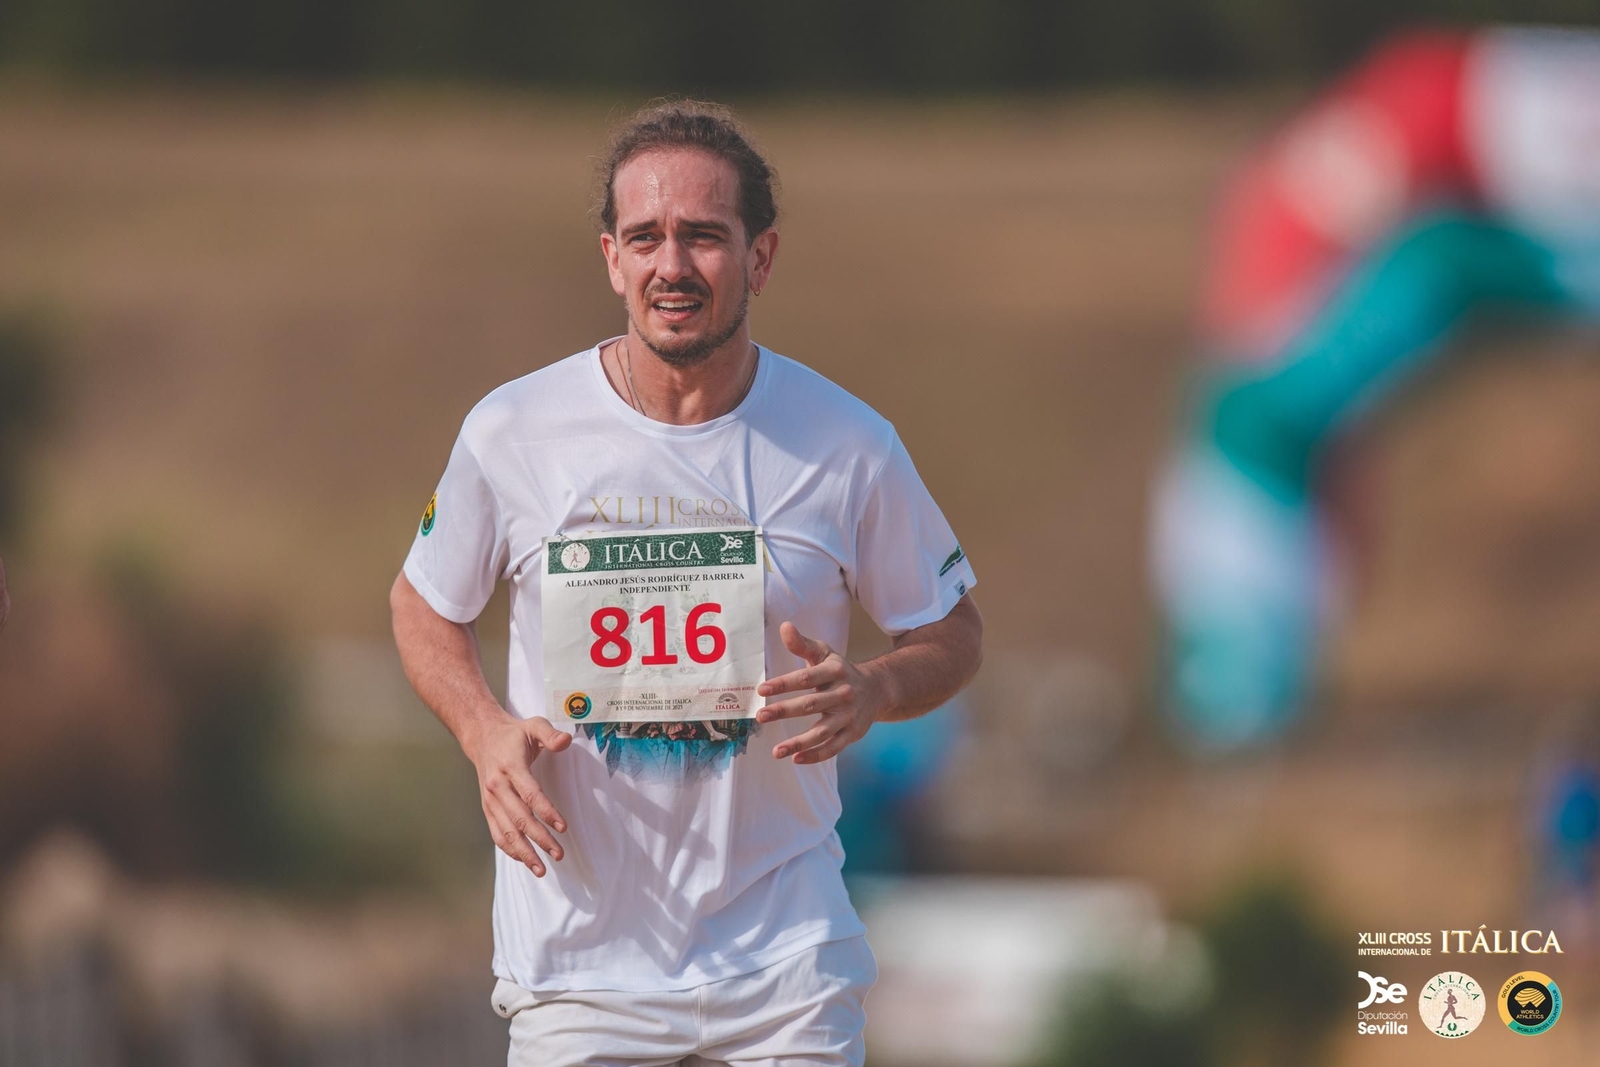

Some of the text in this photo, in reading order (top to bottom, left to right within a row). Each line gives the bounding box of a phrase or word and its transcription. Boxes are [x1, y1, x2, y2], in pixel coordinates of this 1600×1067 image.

[588, 496, 677, 525] XLIII
[604, 538, 705, 564] ITÁLICA
[604, 562, 654, 570] INTERNATIONAL
[720, 556, 744, 564] Sevilla
[565, 572, 745, 589] ALEJANDRO JESÚS RODRÍGUEZ BARRERA
[619, 584, 691, 595] INDEPENDIENTE
[590, 602, 727, 668] 816
